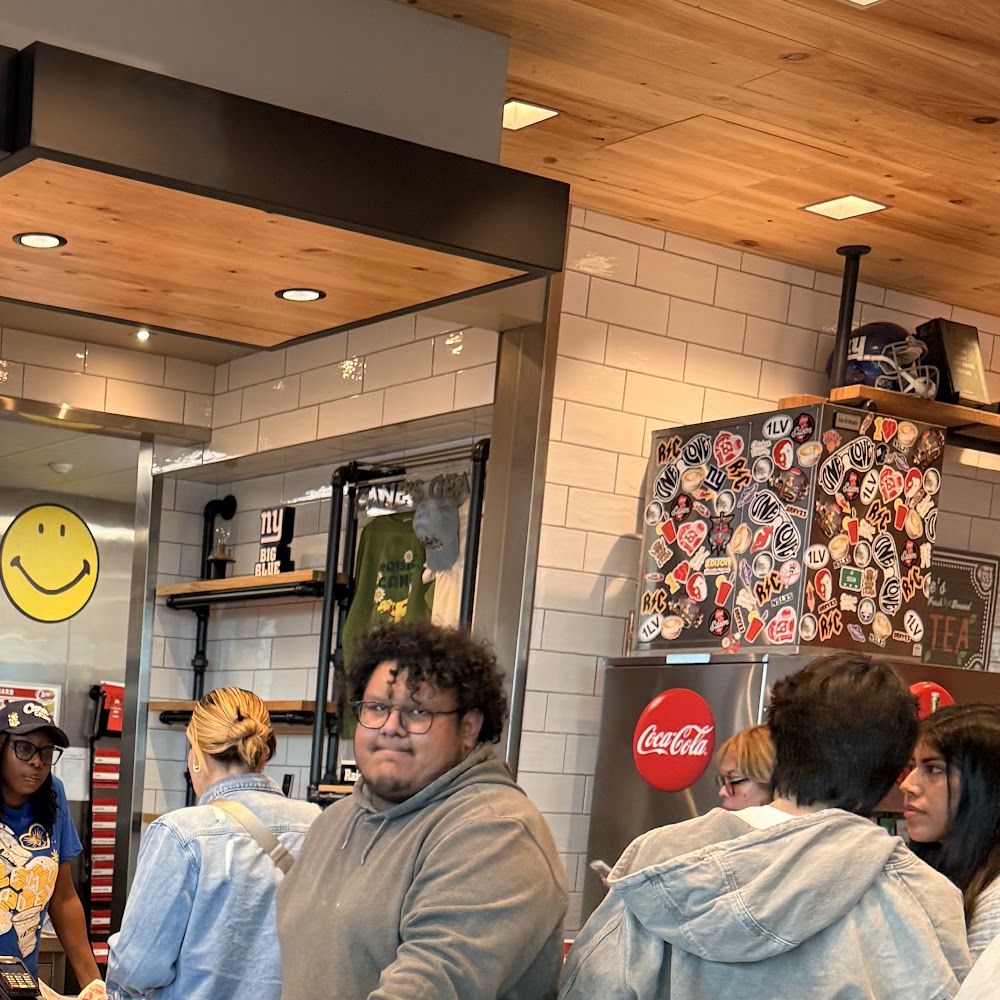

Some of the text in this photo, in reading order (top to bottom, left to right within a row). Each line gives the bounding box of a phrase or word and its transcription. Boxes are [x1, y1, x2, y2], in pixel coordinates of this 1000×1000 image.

[766, 419, 789, 436] 1LV
[862, 474, 877, 499] 1LV
[258, 546, 276, 563] BIG
[807, 550, 826, 564] 1LV
[254, 560, 281, 577] BLUE
[642, 616, 660, 638] 1LV
[906, 614, 922, 636] 1LV
[928, 613, 969, 653] TEA
[637, 723, 715, 756] Coca-Cola
